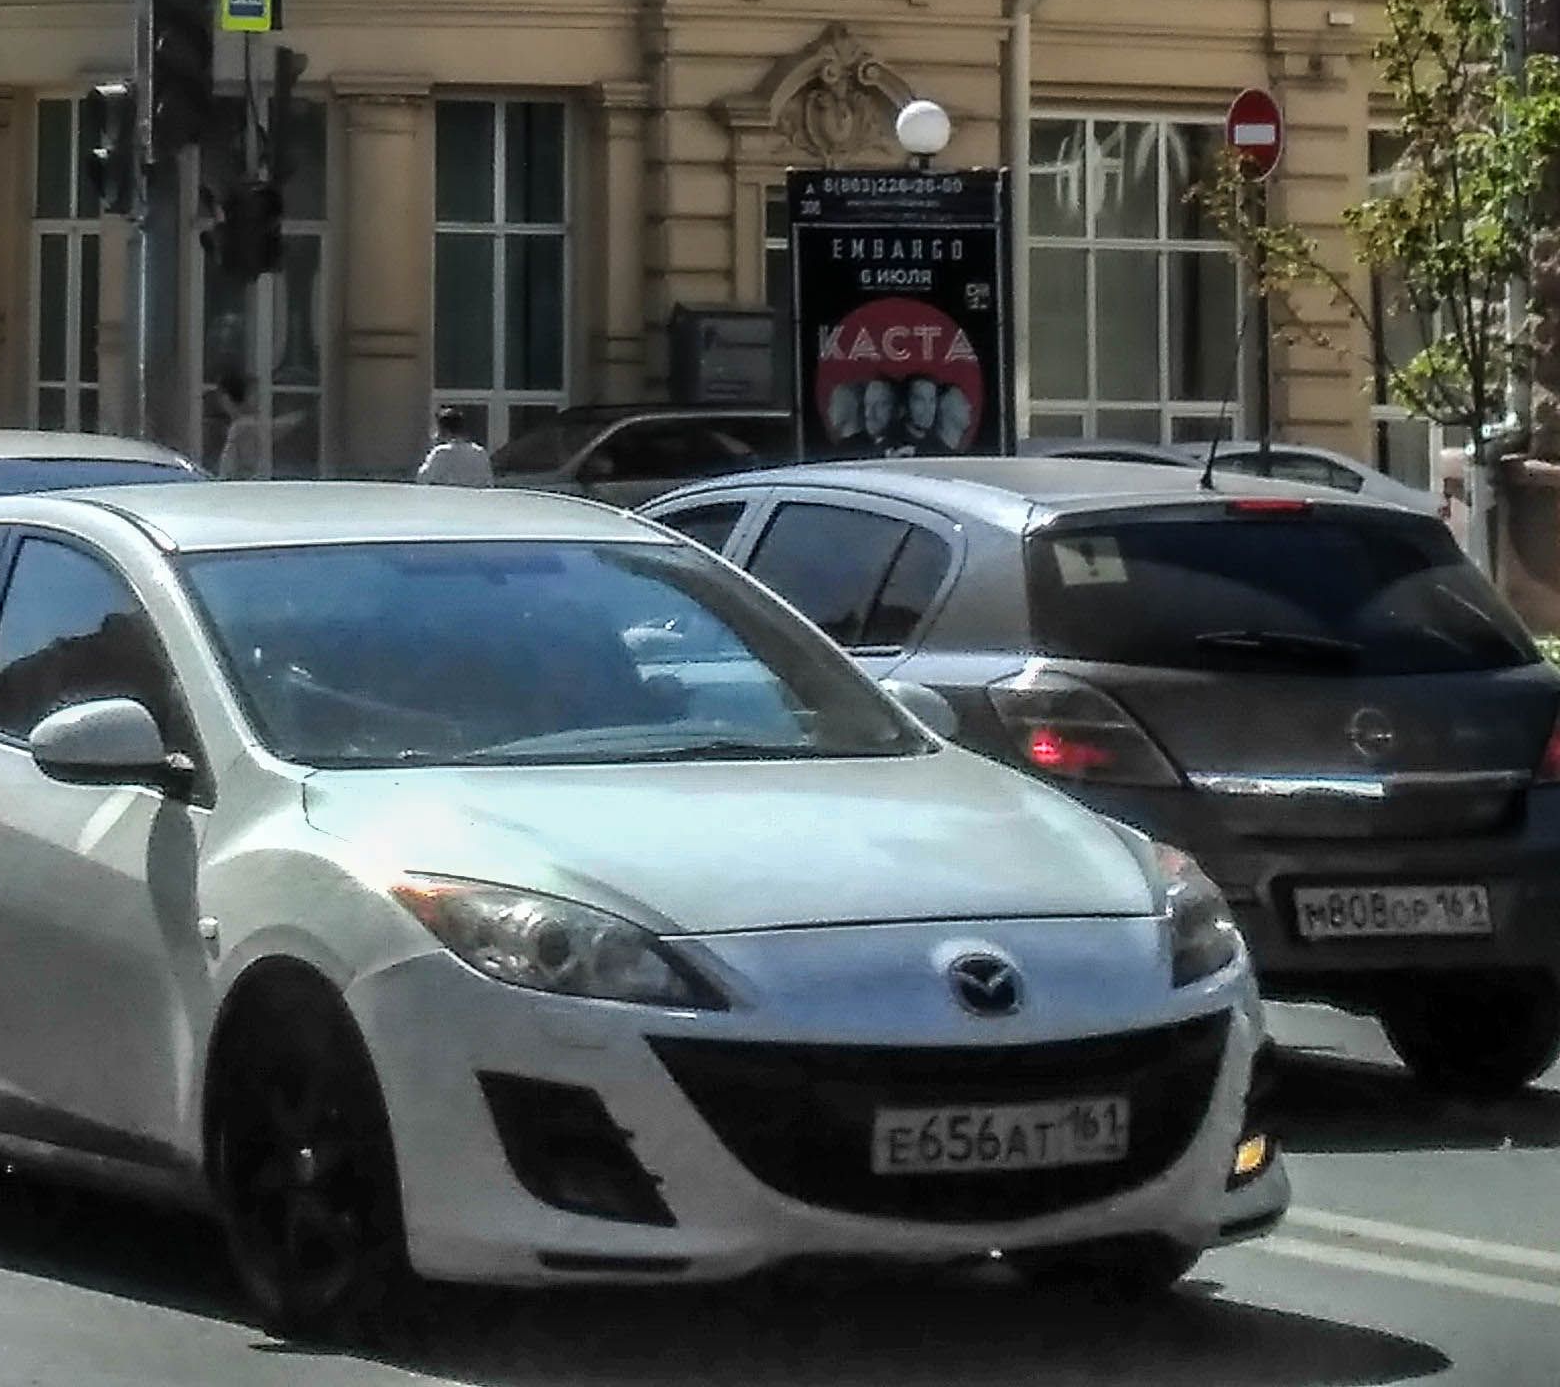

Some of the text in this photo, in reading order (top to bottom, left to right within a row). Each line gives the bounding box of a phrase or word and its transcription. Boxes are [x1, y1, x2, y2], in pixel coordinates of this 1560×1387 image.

[876, 269, 933, 284] ИЮЛЯ
[817, 325, 978, 361] КАСТА
[889, 1114, 1056, 1164] Е656АТ
